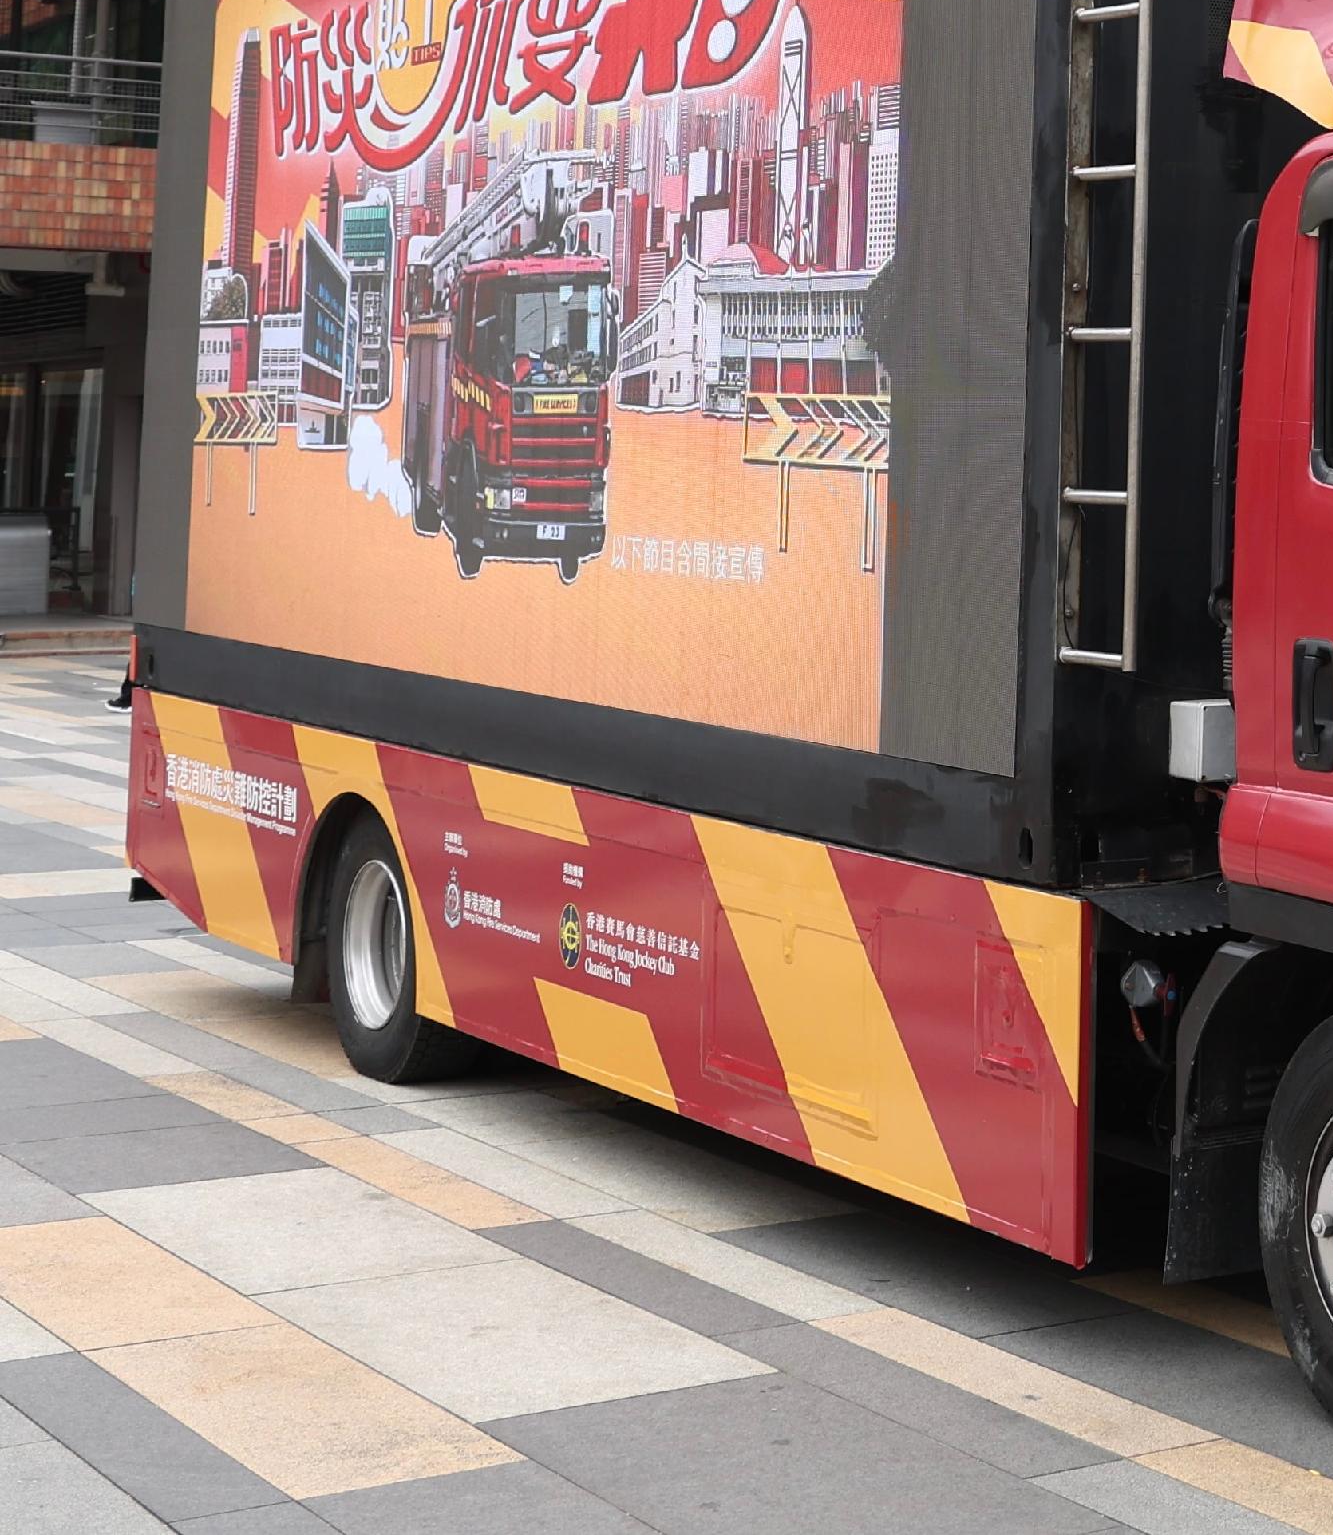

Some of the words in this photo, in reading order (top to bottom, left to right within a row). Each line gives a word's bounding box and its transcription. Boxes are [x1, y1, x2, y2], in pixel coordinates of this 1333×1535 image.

[413, 45, 441, 63] TIPS
[585, 934, 598, 952] The
[598, 937, 617, 963] Hong
[617, 943, 634, 968] Kong
[634, 949, 658, 975] Jockey
[658, 955, 675, 976] Club
[584, 957, 613, 981] Charities
[614, 966, 632, 988] Trust
